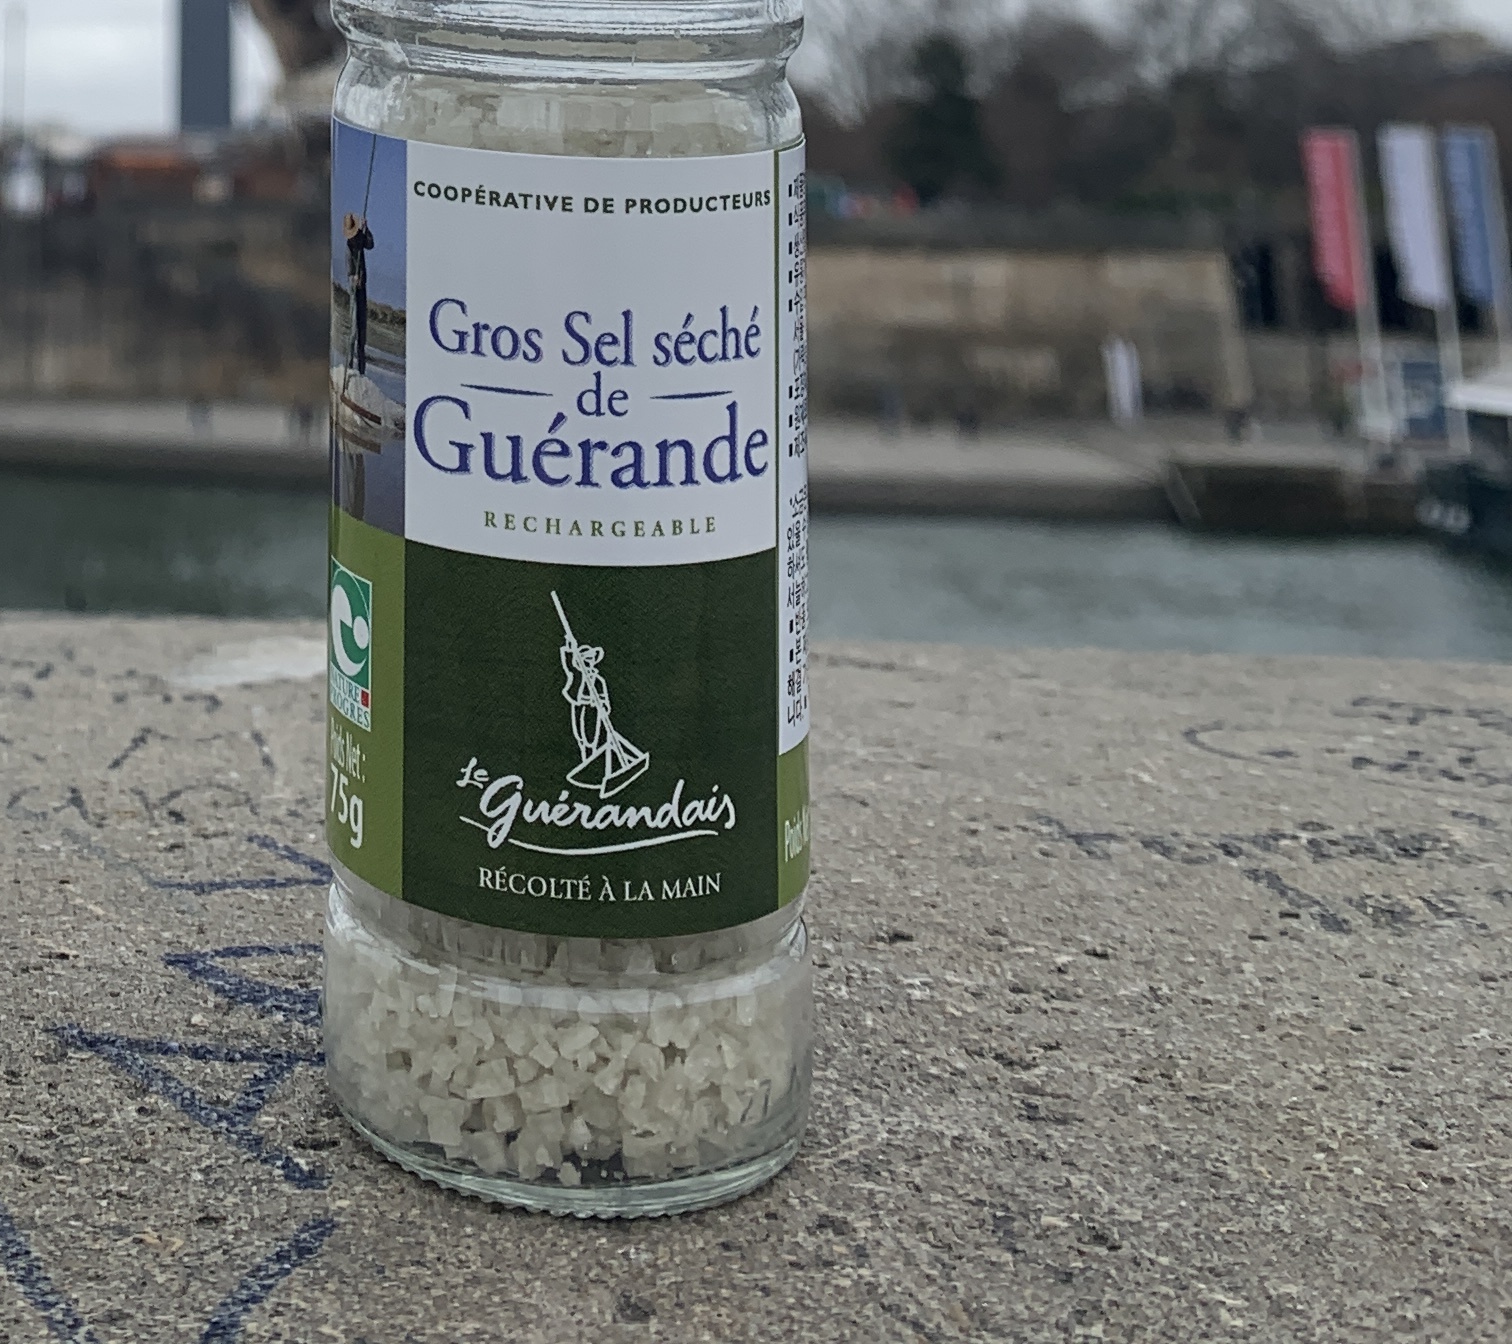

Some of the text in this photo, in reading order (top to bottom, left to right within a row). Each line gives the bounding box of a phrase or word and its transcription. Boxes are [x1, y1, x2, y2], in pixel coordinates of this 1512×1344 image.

[413, 180, 771, 214] COOPÉRATIVE DE PRODUCTEURS
[429, 297, 762, 368] Gros Sel séché
[576, 371, 630, 417] de
[412, 394, 770, 489] Guérande
[484, 510, 717, 539] RECHARGEABLE
[456, 756, 489, 790] Le
[330, 761, 364, 849] 75g
[479, 774, 737, 849] Guérandais
[478, 865, 722, 902] RÉCOLTÉ À LA MAIN
